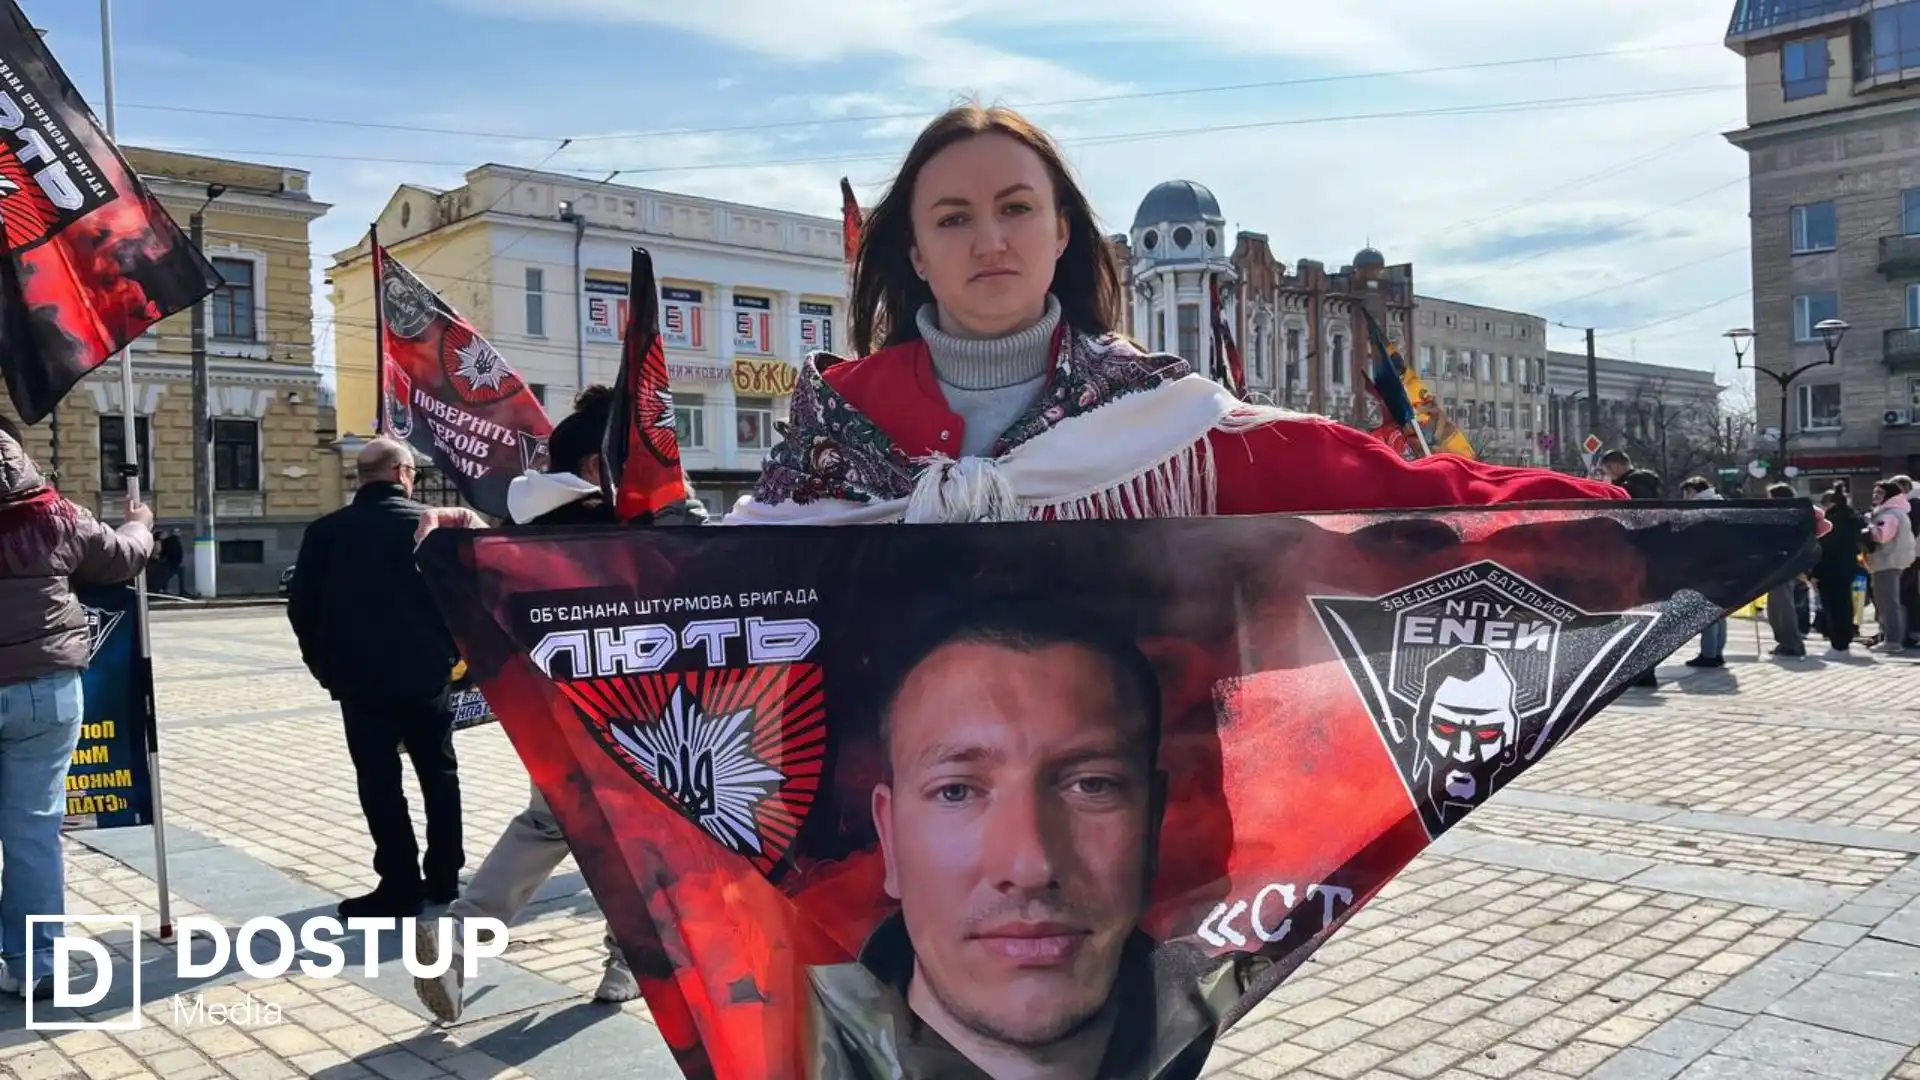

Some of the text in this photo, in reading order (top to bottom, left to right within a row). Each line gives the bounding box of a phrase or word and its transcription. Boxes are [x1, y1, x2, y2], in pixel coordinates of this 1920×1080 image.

[0, 57, 107, 198] НАНА ШТУРМОВА БРИГАДА
[414, 389, 516, 446] ПОВЕРНІТЬ
[530, 588, 819, 623] ОБ'ЄДНАНА ШТУРМОВА БРИГАДА
[1380, 568, 1577, 622] ЗВЕДЕНИЙ БАТАЛЬЙОН
[529, 616, 820, 679] ЛЮТЬ
